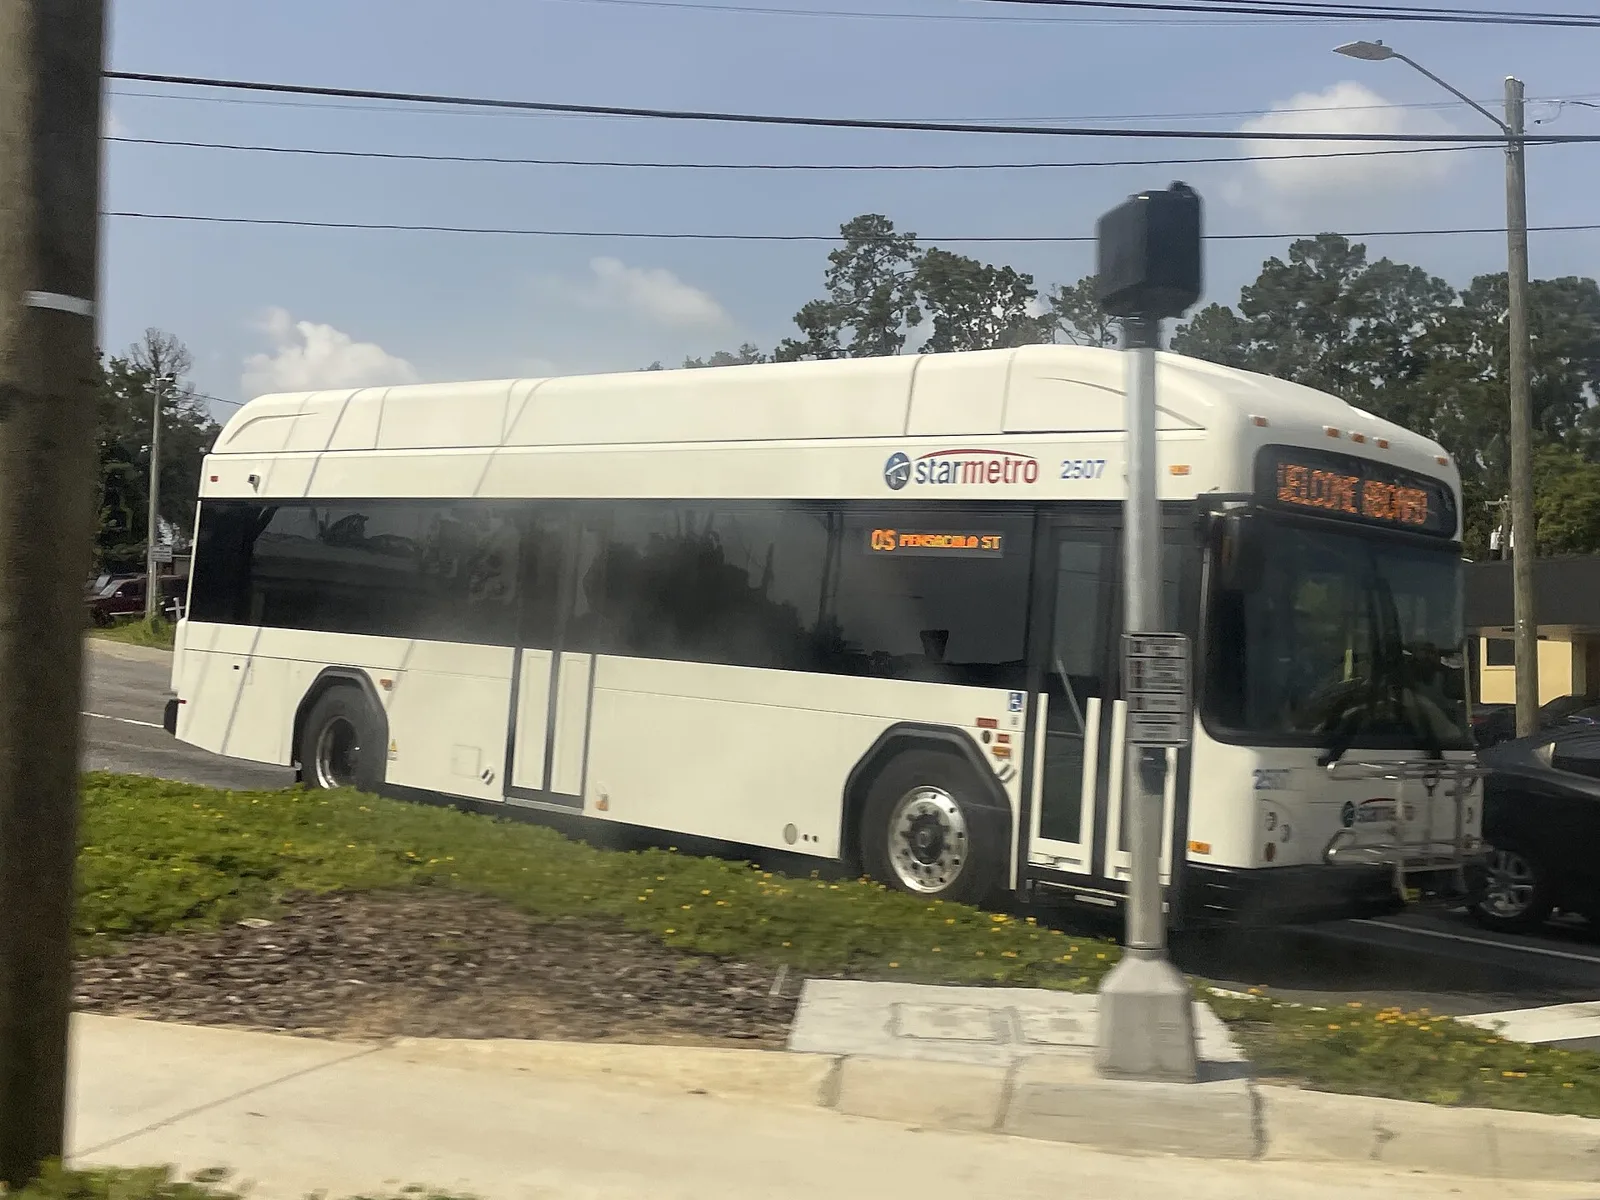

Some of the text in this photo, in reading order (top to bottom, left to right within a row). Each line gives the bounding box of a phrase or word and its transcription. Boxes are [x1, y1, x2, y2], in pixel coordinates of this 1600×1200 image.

[915, 456, 1038, 484] starmetro
[1060, 459, 1106, 480] 2507
[981, 535, 1002, 549] ST
